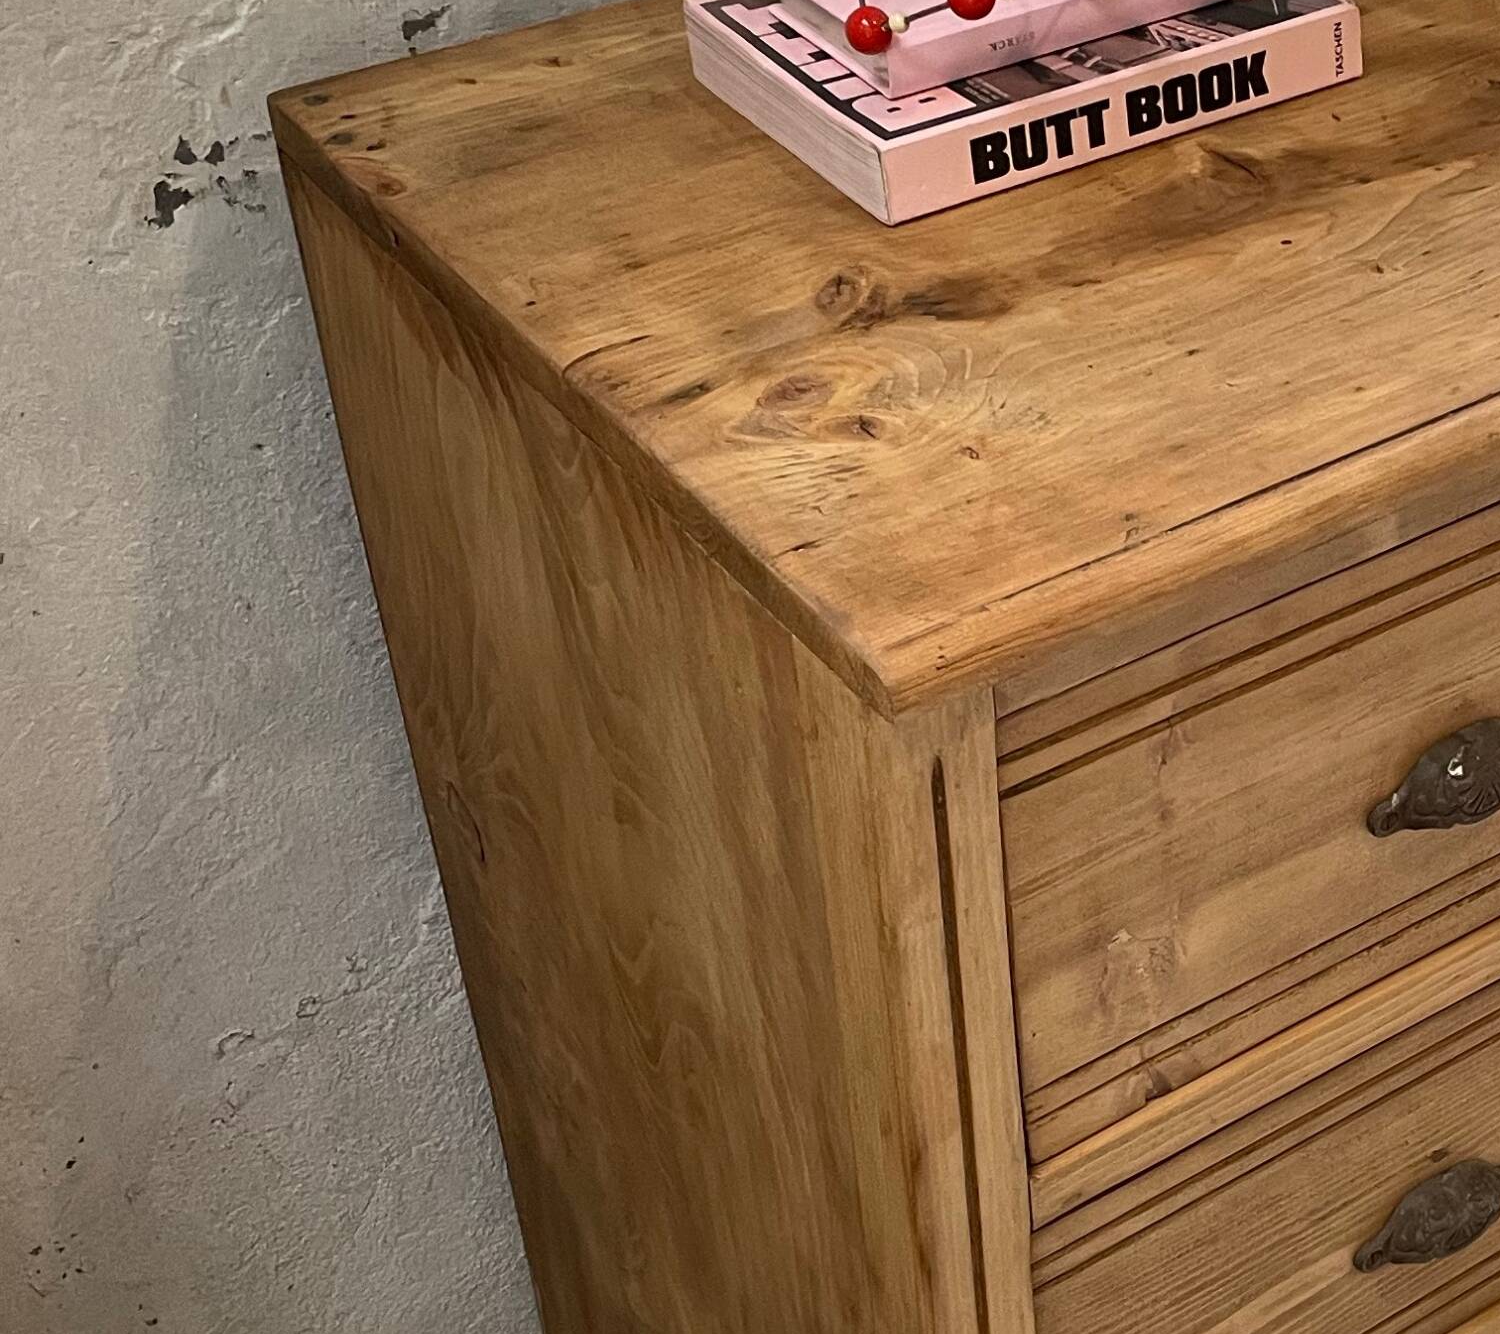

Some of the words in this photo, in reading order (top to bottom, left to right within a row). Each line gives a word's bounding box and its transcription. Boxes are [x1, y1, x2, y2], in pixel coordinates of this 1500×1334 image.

[1333, 21, 1345, 78] TASCHEN
[969, 98, 1110, 185] BUTT
[1125, 49, 1270, 137] BOOK
